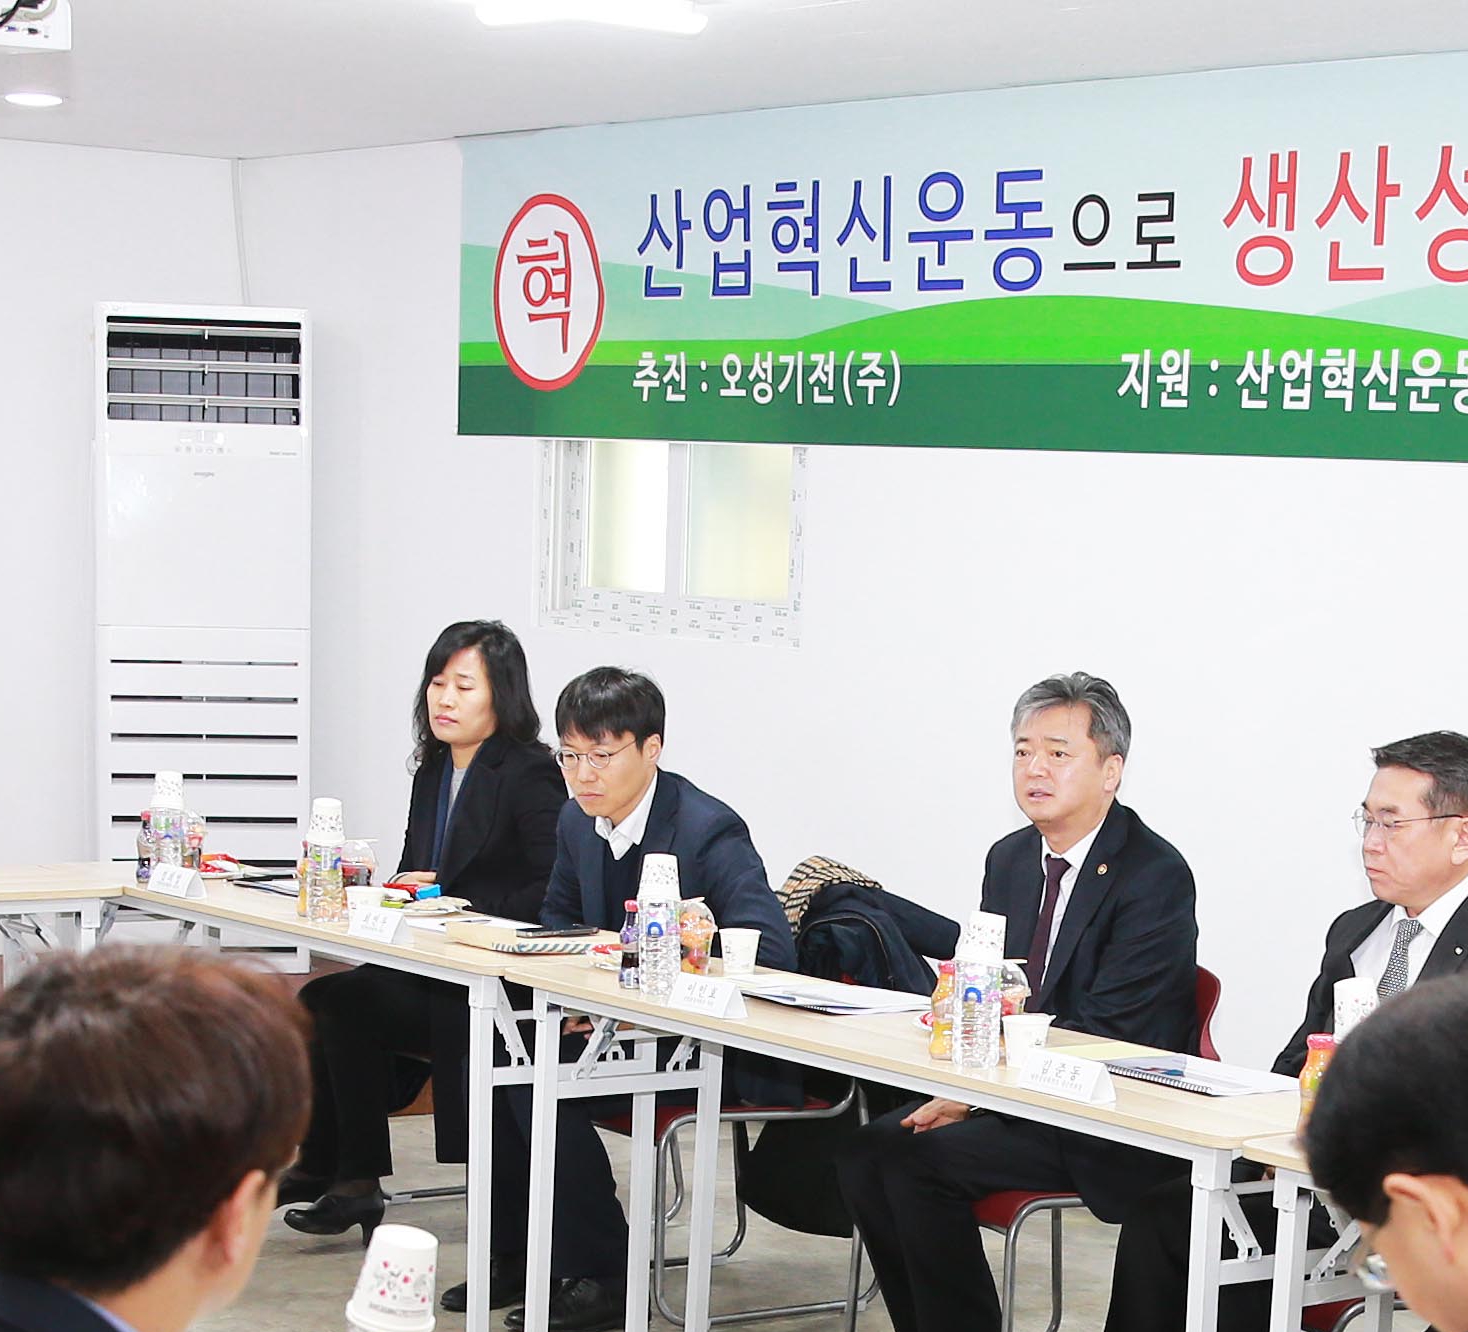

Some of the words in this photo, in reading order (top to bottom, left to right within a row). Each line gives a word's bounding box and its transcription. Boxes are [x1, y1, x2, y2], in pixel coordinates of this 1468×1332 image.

[635, 167, 1183, 300] 산업혁신운동으로
[516, 229, 571, 355] 혁
[631, 352, 688, 405] 추진
[720, 350, 902, 410] 오성기전(주)
[1116, 349, 1192, 410] 지원
